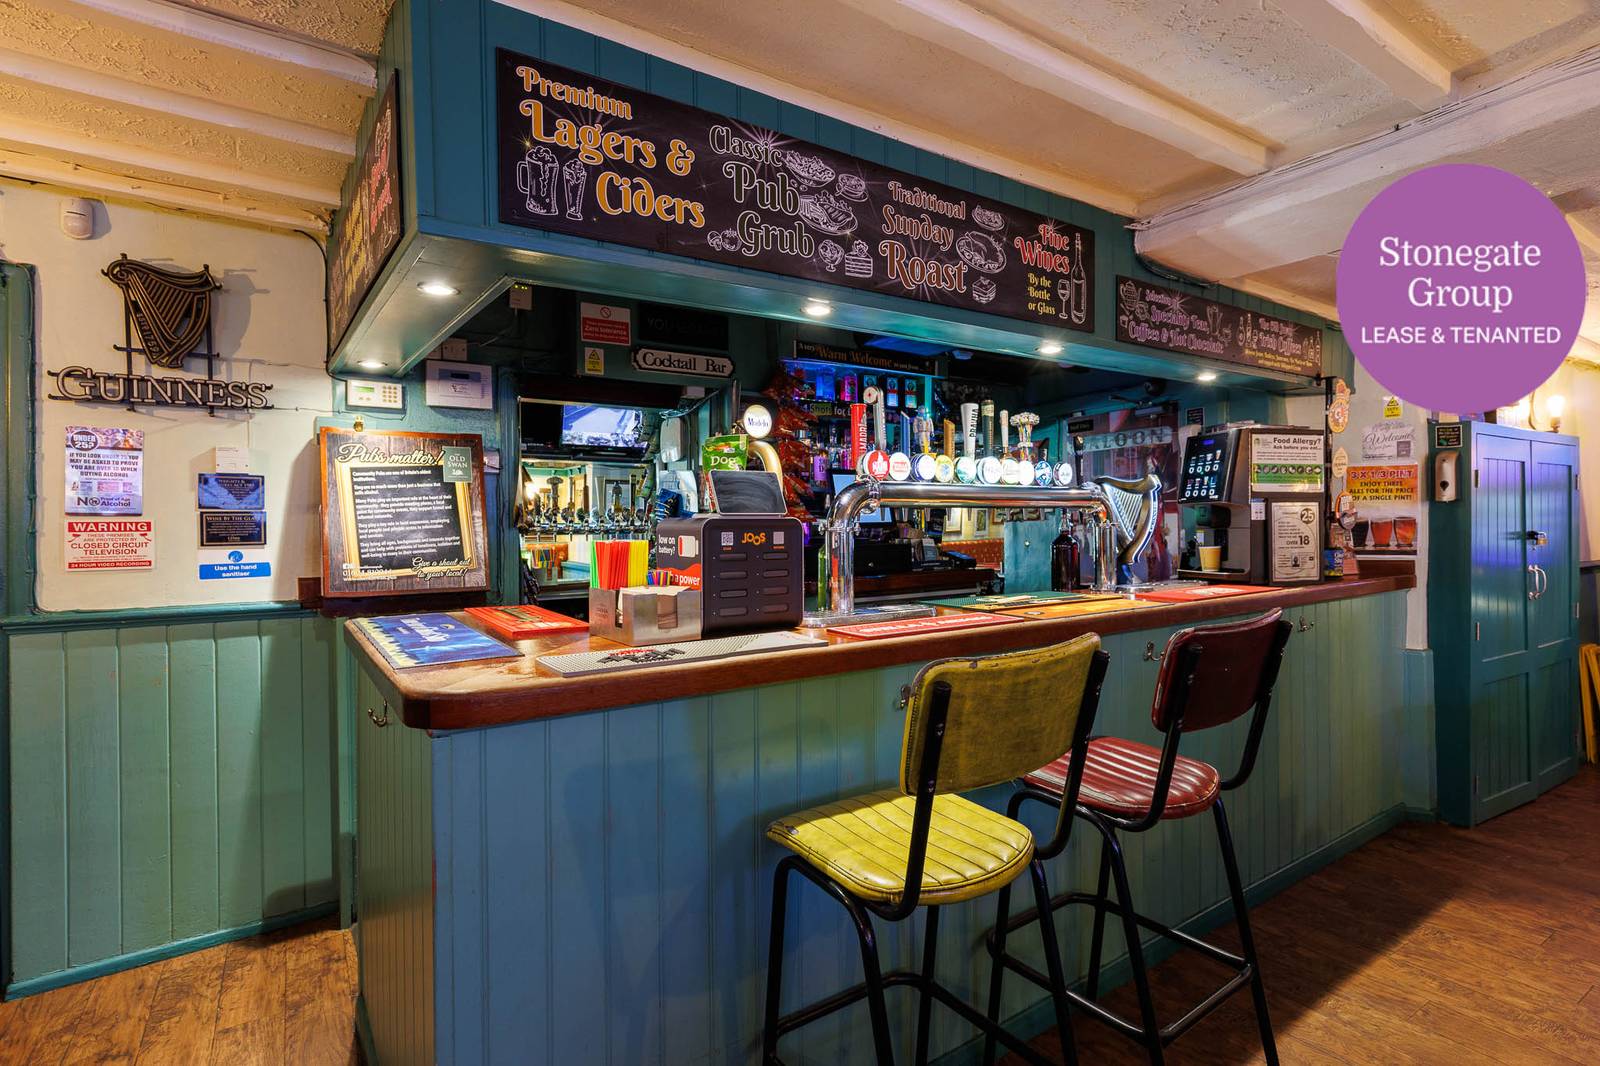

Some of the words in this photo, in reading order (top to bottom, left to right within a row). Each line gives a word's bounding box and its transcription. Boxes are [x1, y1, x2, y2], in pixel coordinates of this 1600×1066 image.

[516, 65, 632, 120] Premium
[520, 99, 657, 170] Lagers
[666, 139, 695, 176] &
[709, 125, 783, 168] Classic
[723, 161, 800, 217] Pub
[596, 171, 705, 229] Ciders
[888, 180, 966, 220] Traditional
[737, 211, 815, 259] Grub
[881, 204, 954, 251] Sunday
[1038, 223, 1070, 252] Fine
[1014, 236, 1070, 274] Wines
[879, 240, 968, 293] Roast
[1028, 273, 1040, 288] By
[1041, 275, 1052, 289] the
[1028, 286, 1051, 302] Bottle
[1028, 302, 1038, 312] or
[1038, 302, 1056, 316] Glass
[642, 351, 696, 371] Cocktail
[705, 358, 726, 373] Bar
[816, 345, 847, 361] Warm
[851, 352, 893, 368] Welcome
[57, 366, 268, 408] GUINNESS
[969, 409, 979, 438] PRAVHA
[1292, 437, 1322, 446] Allergy?
[1365, 432, 1413, 445] Welcome
[336, 442, 387, 463] Pubs
[388, 449, 446, 466] matter!
[447, 461, 468, 469] SWAN
[1351, 471, 1360, 480] 3
[1389, 470, 1413, 479] PINT
[1301, 510, 1314, 522] 25
[72, 522, 148, 532] WARNING
[658, 534, 669, 544] low
[668, 536, 676, 545] on
[742, 532, 766, 545] JOOS
[1298, 535, 1310, 546] 18
[658, 545, 676, 556] battery?
[412, 556, 430, 570] Give
[417, 569, 425, 577] to
[425, 571, 445, 581] your
[446, 569, 468, 578] local!
[680, 574, 700, 586] power
